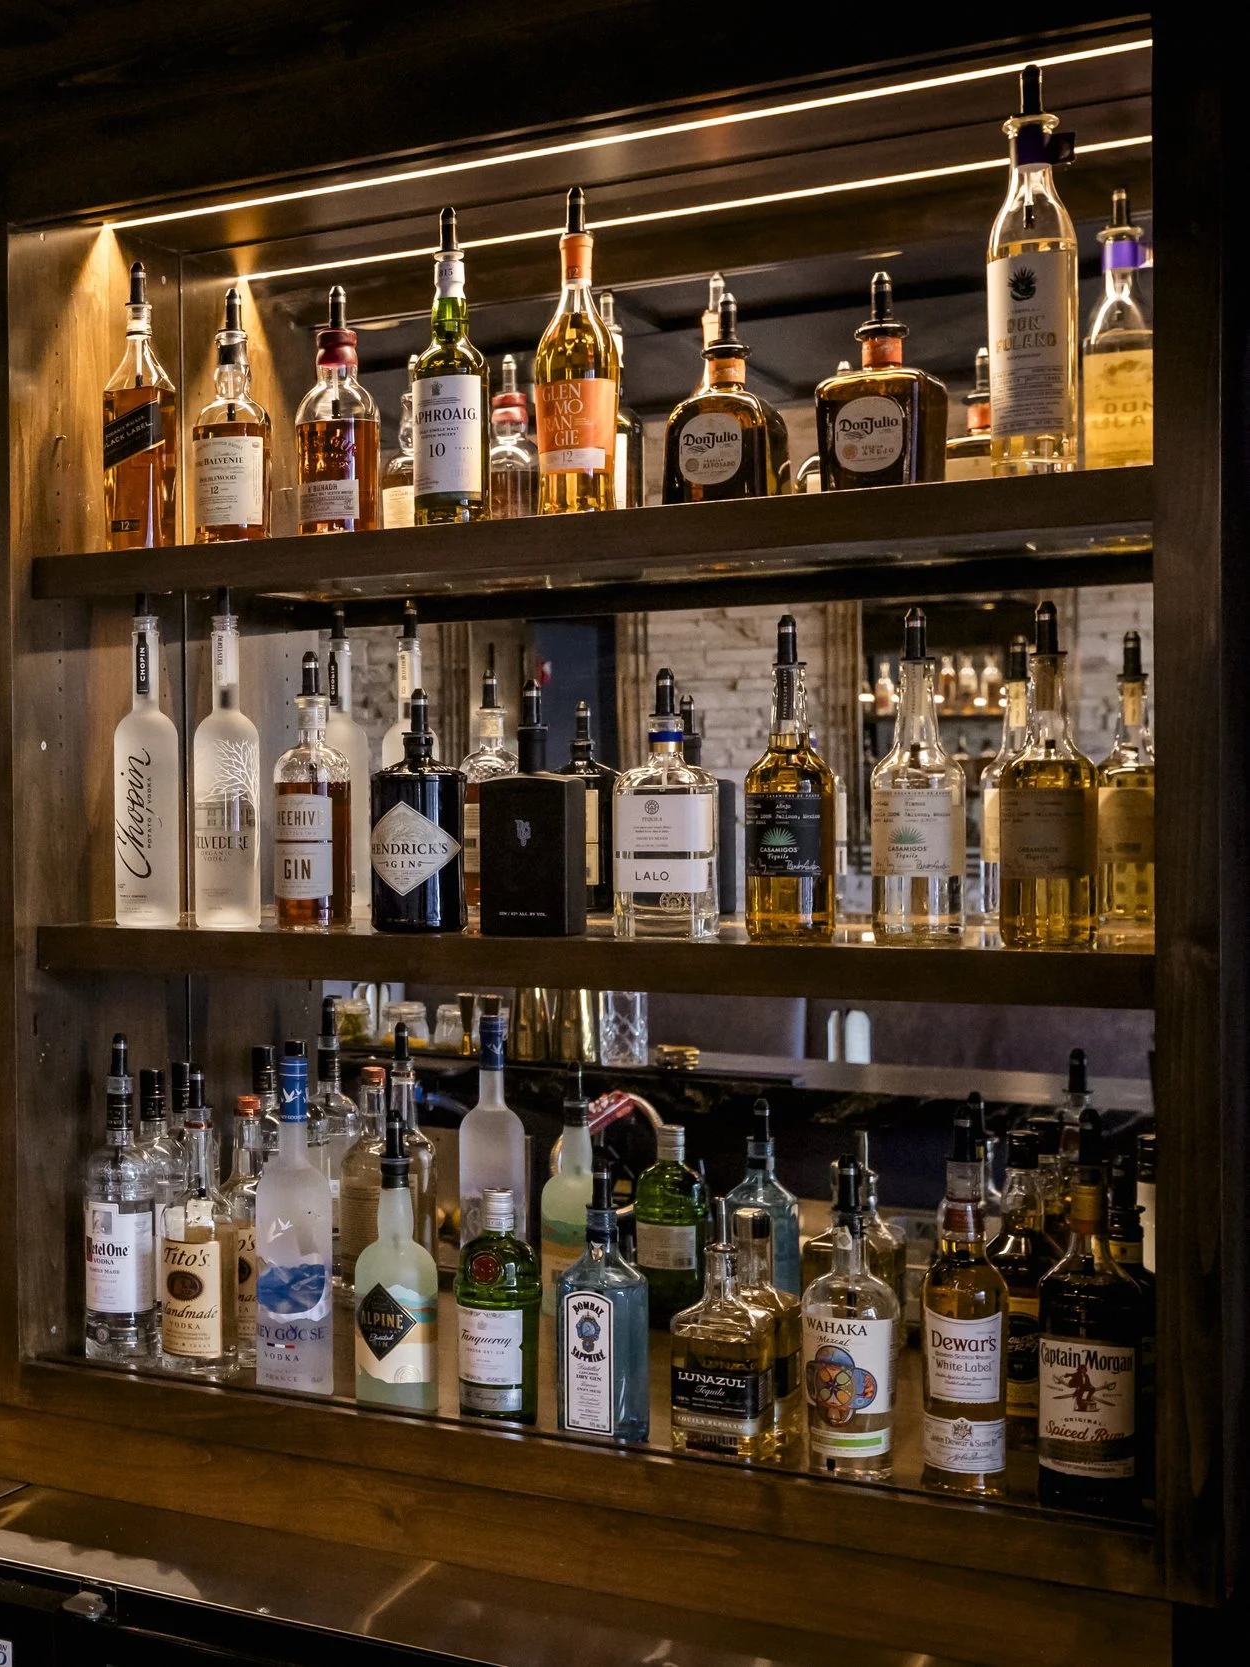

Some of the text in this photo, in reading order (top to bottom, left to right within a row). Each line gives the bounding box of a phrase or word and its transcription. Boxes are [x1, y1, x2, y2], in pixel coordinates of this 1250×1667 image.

[1007, 315, 1041, 334] DON
[542, 383, 582, 400] GLEN
[554, 399, 583, 415] MO
[415, 407, 475, 425] APHROAIG
[544, 415, 573, 432] RAN
[126, 421, 152, 437] LABEL
[554, 430, 579, 447] GIE
[429, 443, 446, 458] 10
[561, 451, 573, 462] 12
[204, 456, 244, 465] BALVENIE
[210, 486, 219, 494] 12
[120, 520, 130, 531] 12
[116, 748, 154, 879] Chopin
[371, 843, 448, 855] HENDRICK'S
[283, 859, 312, 880] GIN
[390, 860, 416, 868] GIN
[635, 871, 669, 881] LALO
[93, 1258, 115, 1266] VODKA
[163, 1246, 210, 1267] Tito's
[571, 1301, 605, 1318] BOMBAY
[169, 1321, 201, 1330] VODKA
[360, 1310, 404, 1330] ALPINE
[806, 1316, 868, 1336] WAHAKA
[461, 1329, 512, 1348] Tanqueray
[818, 1335, 851, 1347] Mezcal
[931, 1329, 996, 1352] Dewar's
[264, 1351, 299, 1361] VODKA
[570, 1346, 606, 1363] SAPPHIRE
[1040, 1342, 1081, 1368] Captain
[1081, 1349, 1134, 1375] Morgan
[677, 1371, 746, 1389] LUNAZUL
[694, 1385, 726, 1397] Tequila
[1045, 1419, 1089, 1441] Spiced
